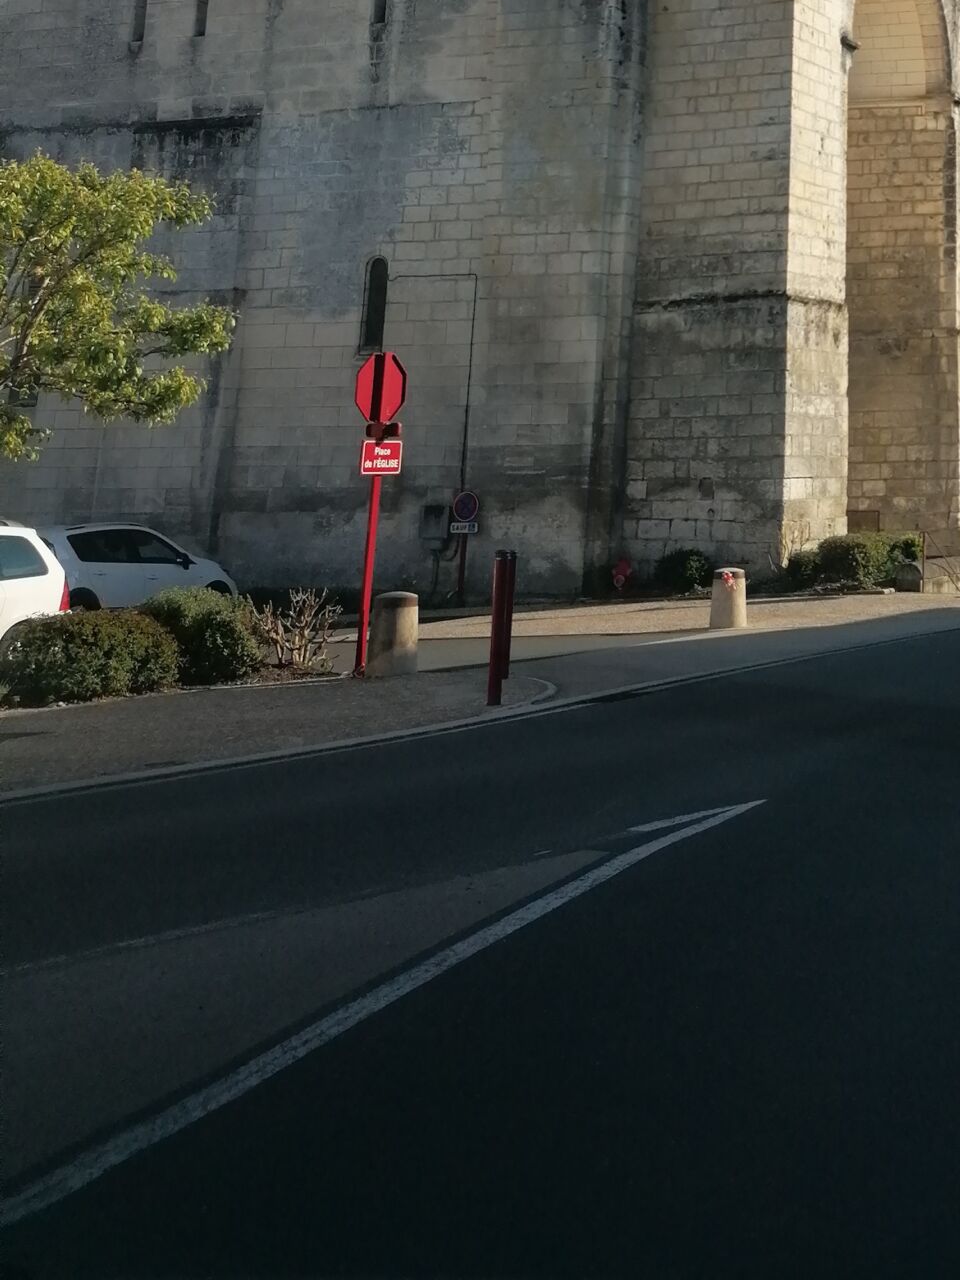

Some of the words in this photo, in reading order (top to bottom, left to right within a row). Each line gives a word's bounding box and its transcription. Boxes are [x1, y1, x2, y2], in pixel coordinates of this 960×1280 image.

[374, 446, 391, 456] Place
[364, 459, 373, 468] de
[373, 457, 399, 468] l'ÉGLISE
